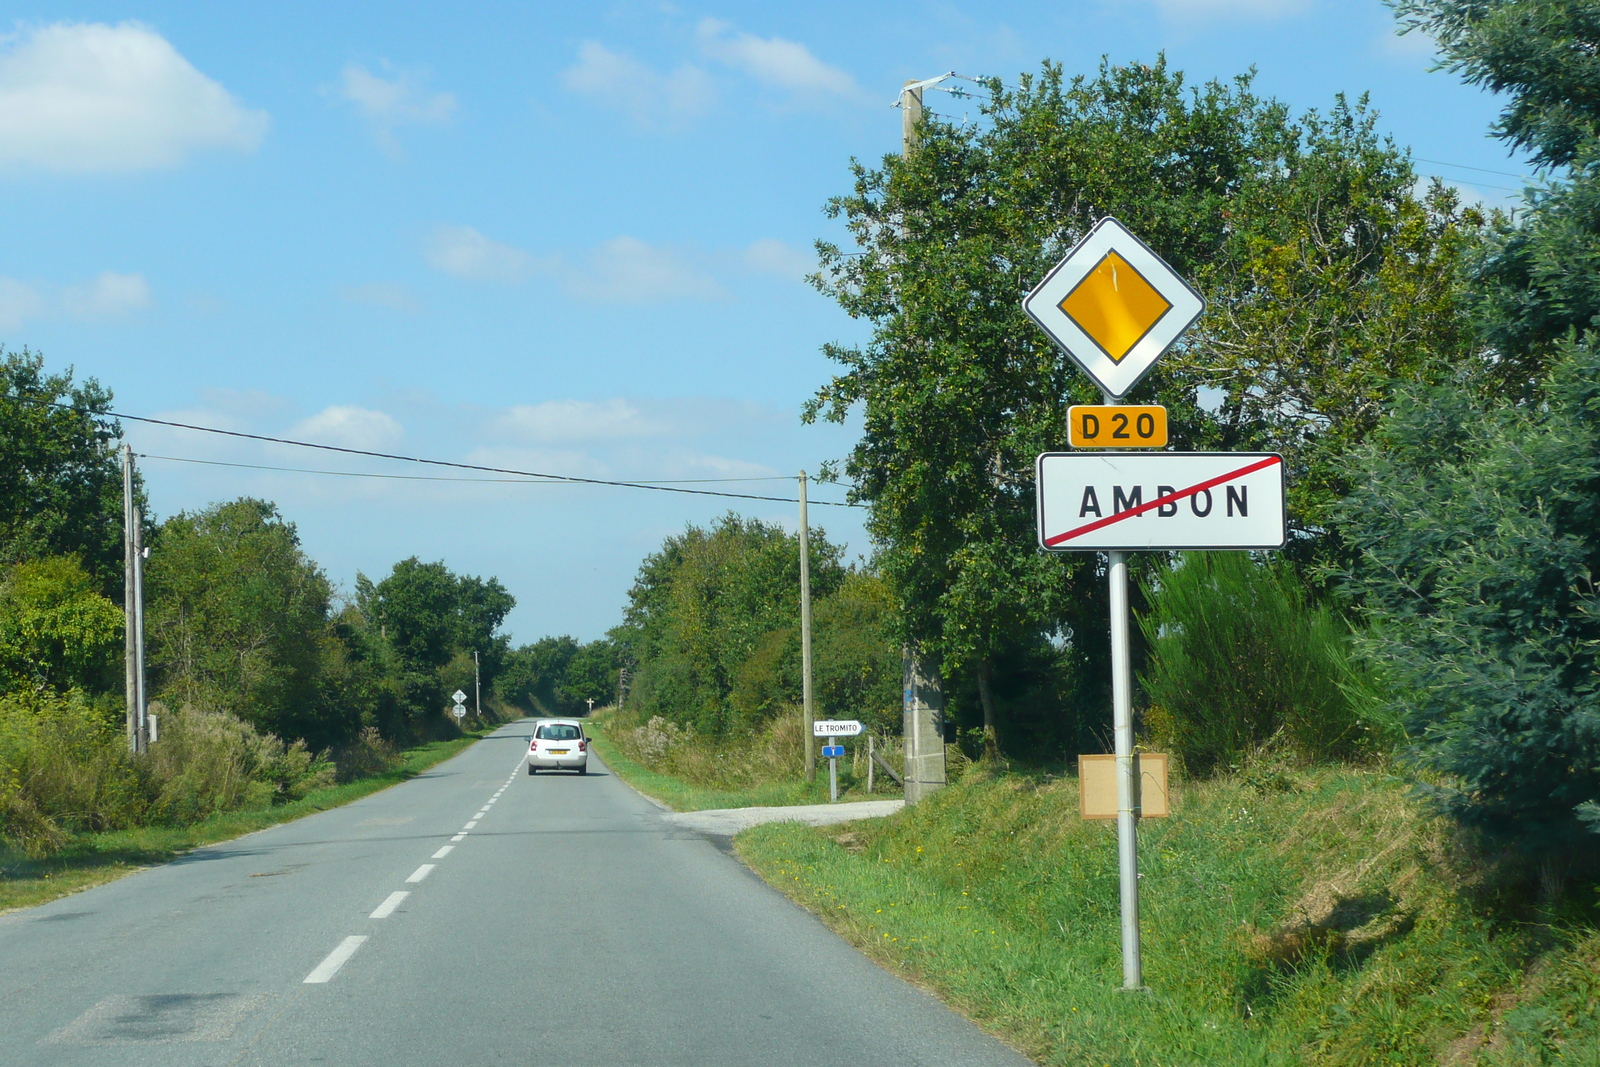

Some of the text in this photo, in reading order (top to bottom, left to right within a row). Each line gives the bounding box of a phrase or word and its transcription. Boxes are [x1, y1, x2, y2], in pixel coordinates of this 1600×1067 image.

[1082, 413, 1155, 439] D 20
[1079, 485, 1248, 518] AMBON
